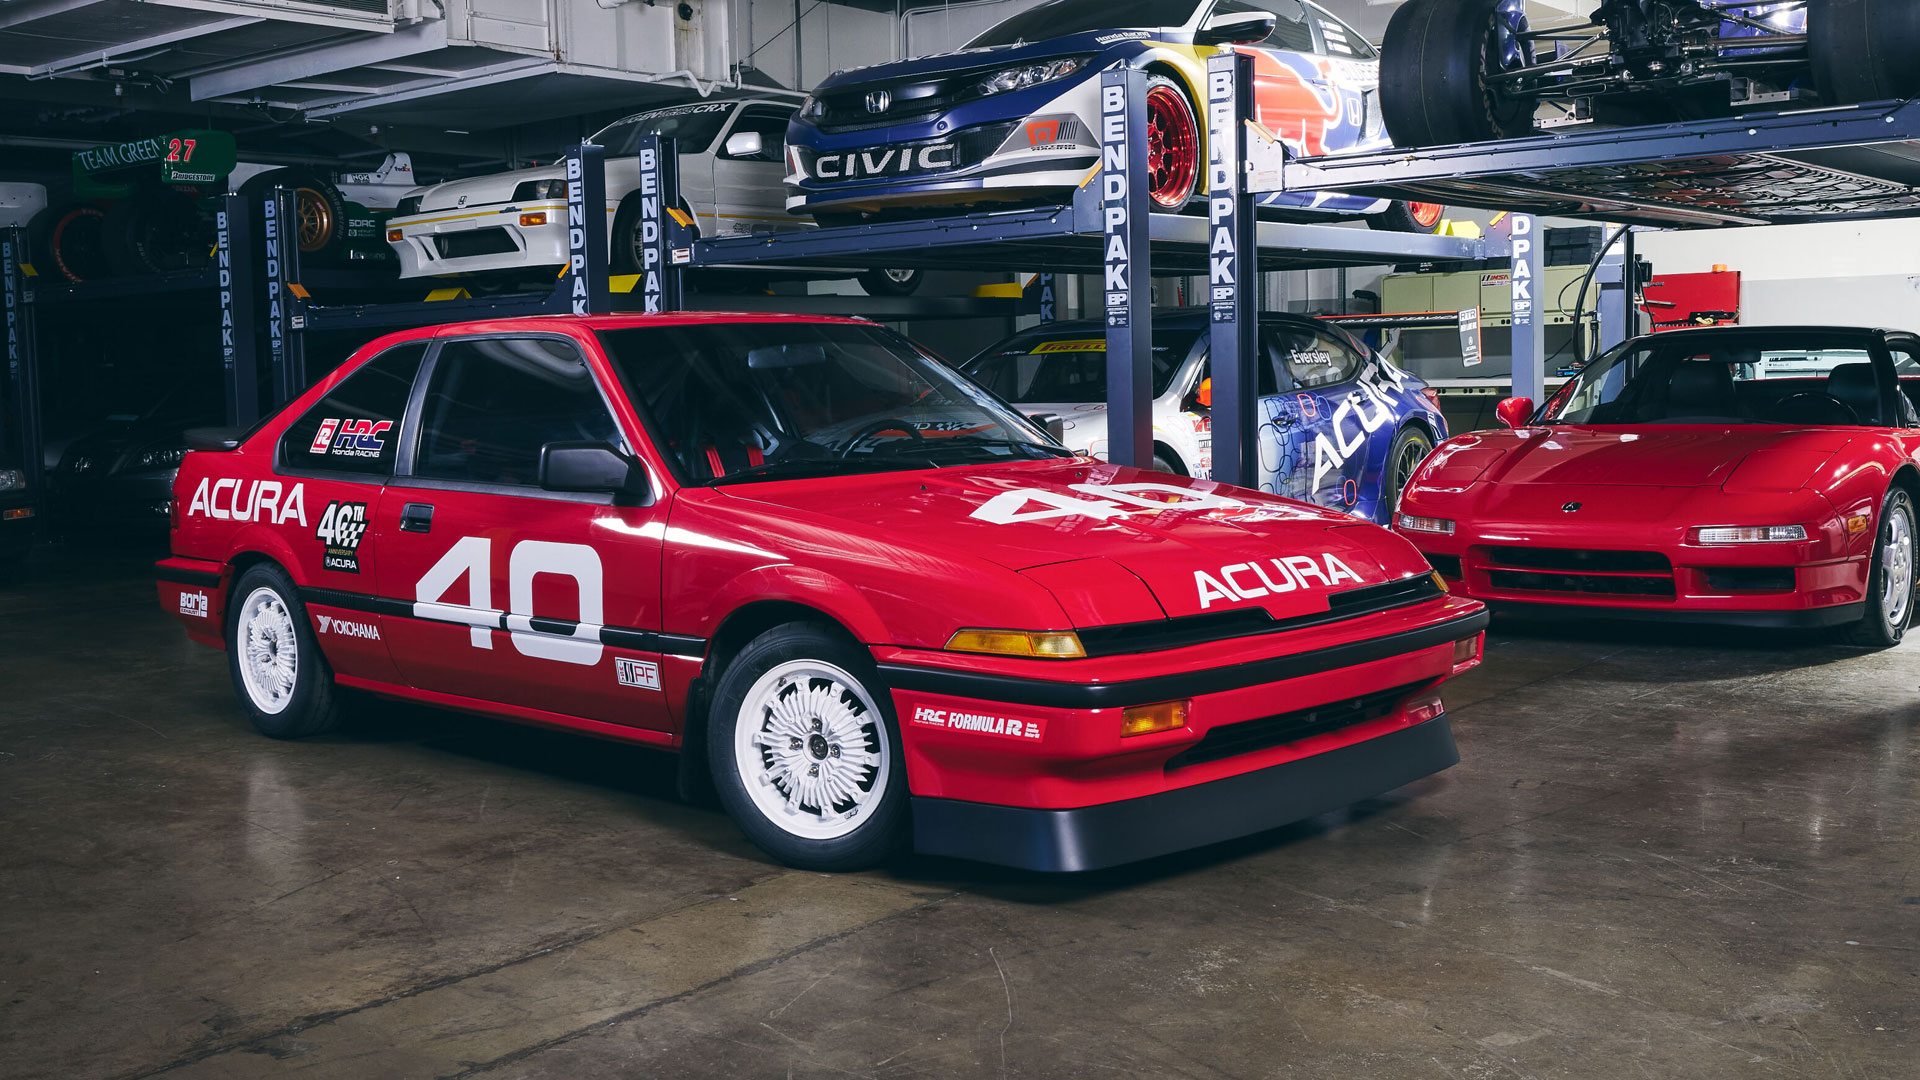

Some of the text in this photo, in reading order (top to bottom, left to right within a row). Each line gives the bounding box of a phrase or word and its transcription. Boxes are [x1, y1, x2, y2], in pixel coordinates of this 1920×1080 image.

[1095, 33, 1123, 42] Honda
[692, 103, 731, 114] CRX
[79, 148, 120, 171] TEAM
[167, 138, 195, 162] 27
[817, 143, 955, 178] CIVIC
[172, 171, 215, 181] BRIDGESTONE
[352, 173, 371, 181] NGK
[1103, 85, 1128, 291] BENDPAK
[566, 157, 587, 315] BENDPAK
[640, 148, 660, 313] BENDPAK
[216, 211, 233, 346] BENDPAK
[264, 200, 282, 338] BENDPAK
[2, 242, 18, 360] BENDPAK
[1107, 293, 1127, 306] BP
[1213, 287, 1235, 300] BP
[1460, 310, 1476, 321] RTR
[1290, 348, 1332, 367] Eversley
[333, 418, 393, 451] HRC
[1312, 351, 1409, 495] ACURA
[355, 450, 380, 458] RACING
[187, 477, 308, 527] ACURA
[968, 482, 1246, 525] 40
[327, 548, 354, 556] ANNIVERSARY
[330, 557, 357, 570] ACURA
[1193, 553, 1364, 609] ACURA
[413, 536, 604, 666] 40
[331, 618, 381, 641] YOKOHAMA
[634, 666, 655, 684] PF
[914, 707, 947, 723] HRC
[947, 712, 1005, 734] FORMULA
[1005, 719, 1023, 737] R
